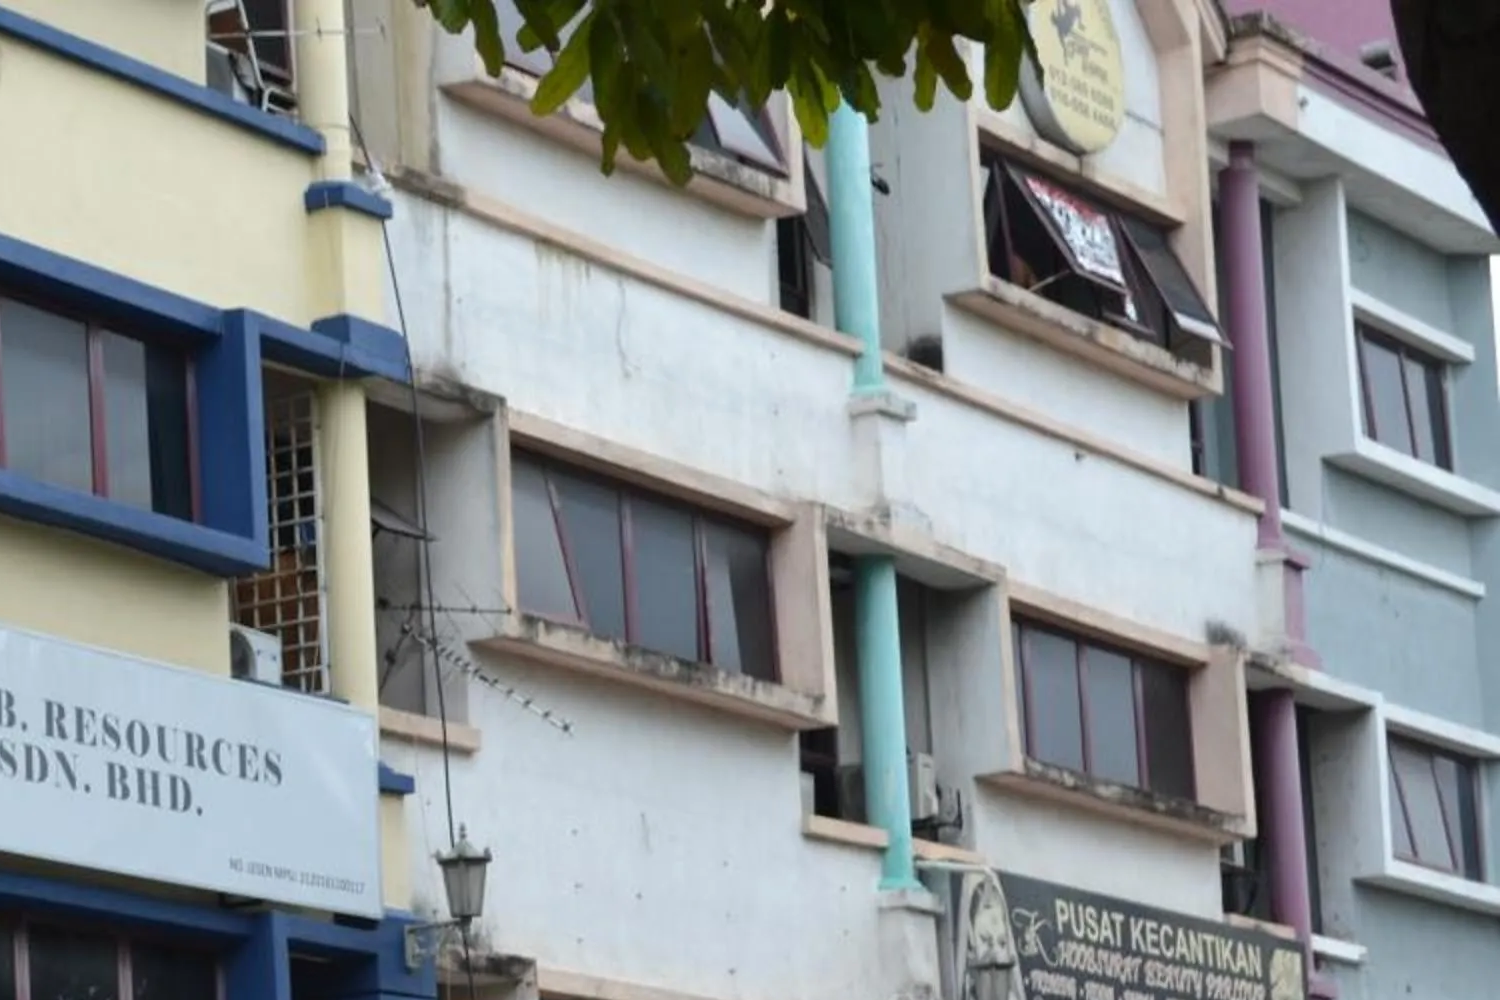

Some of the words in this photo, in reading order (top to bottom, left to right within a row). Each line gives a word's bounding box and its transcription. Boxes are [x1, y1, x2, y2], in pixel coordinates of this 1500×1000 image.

[42, 699, 283, 787] RESOURCES
[106, 760, 204, 817] BHD.
[1055, 898, 1125, 948] PUSAT
[1130, 915, 1263, 979] KECANTIKAN
